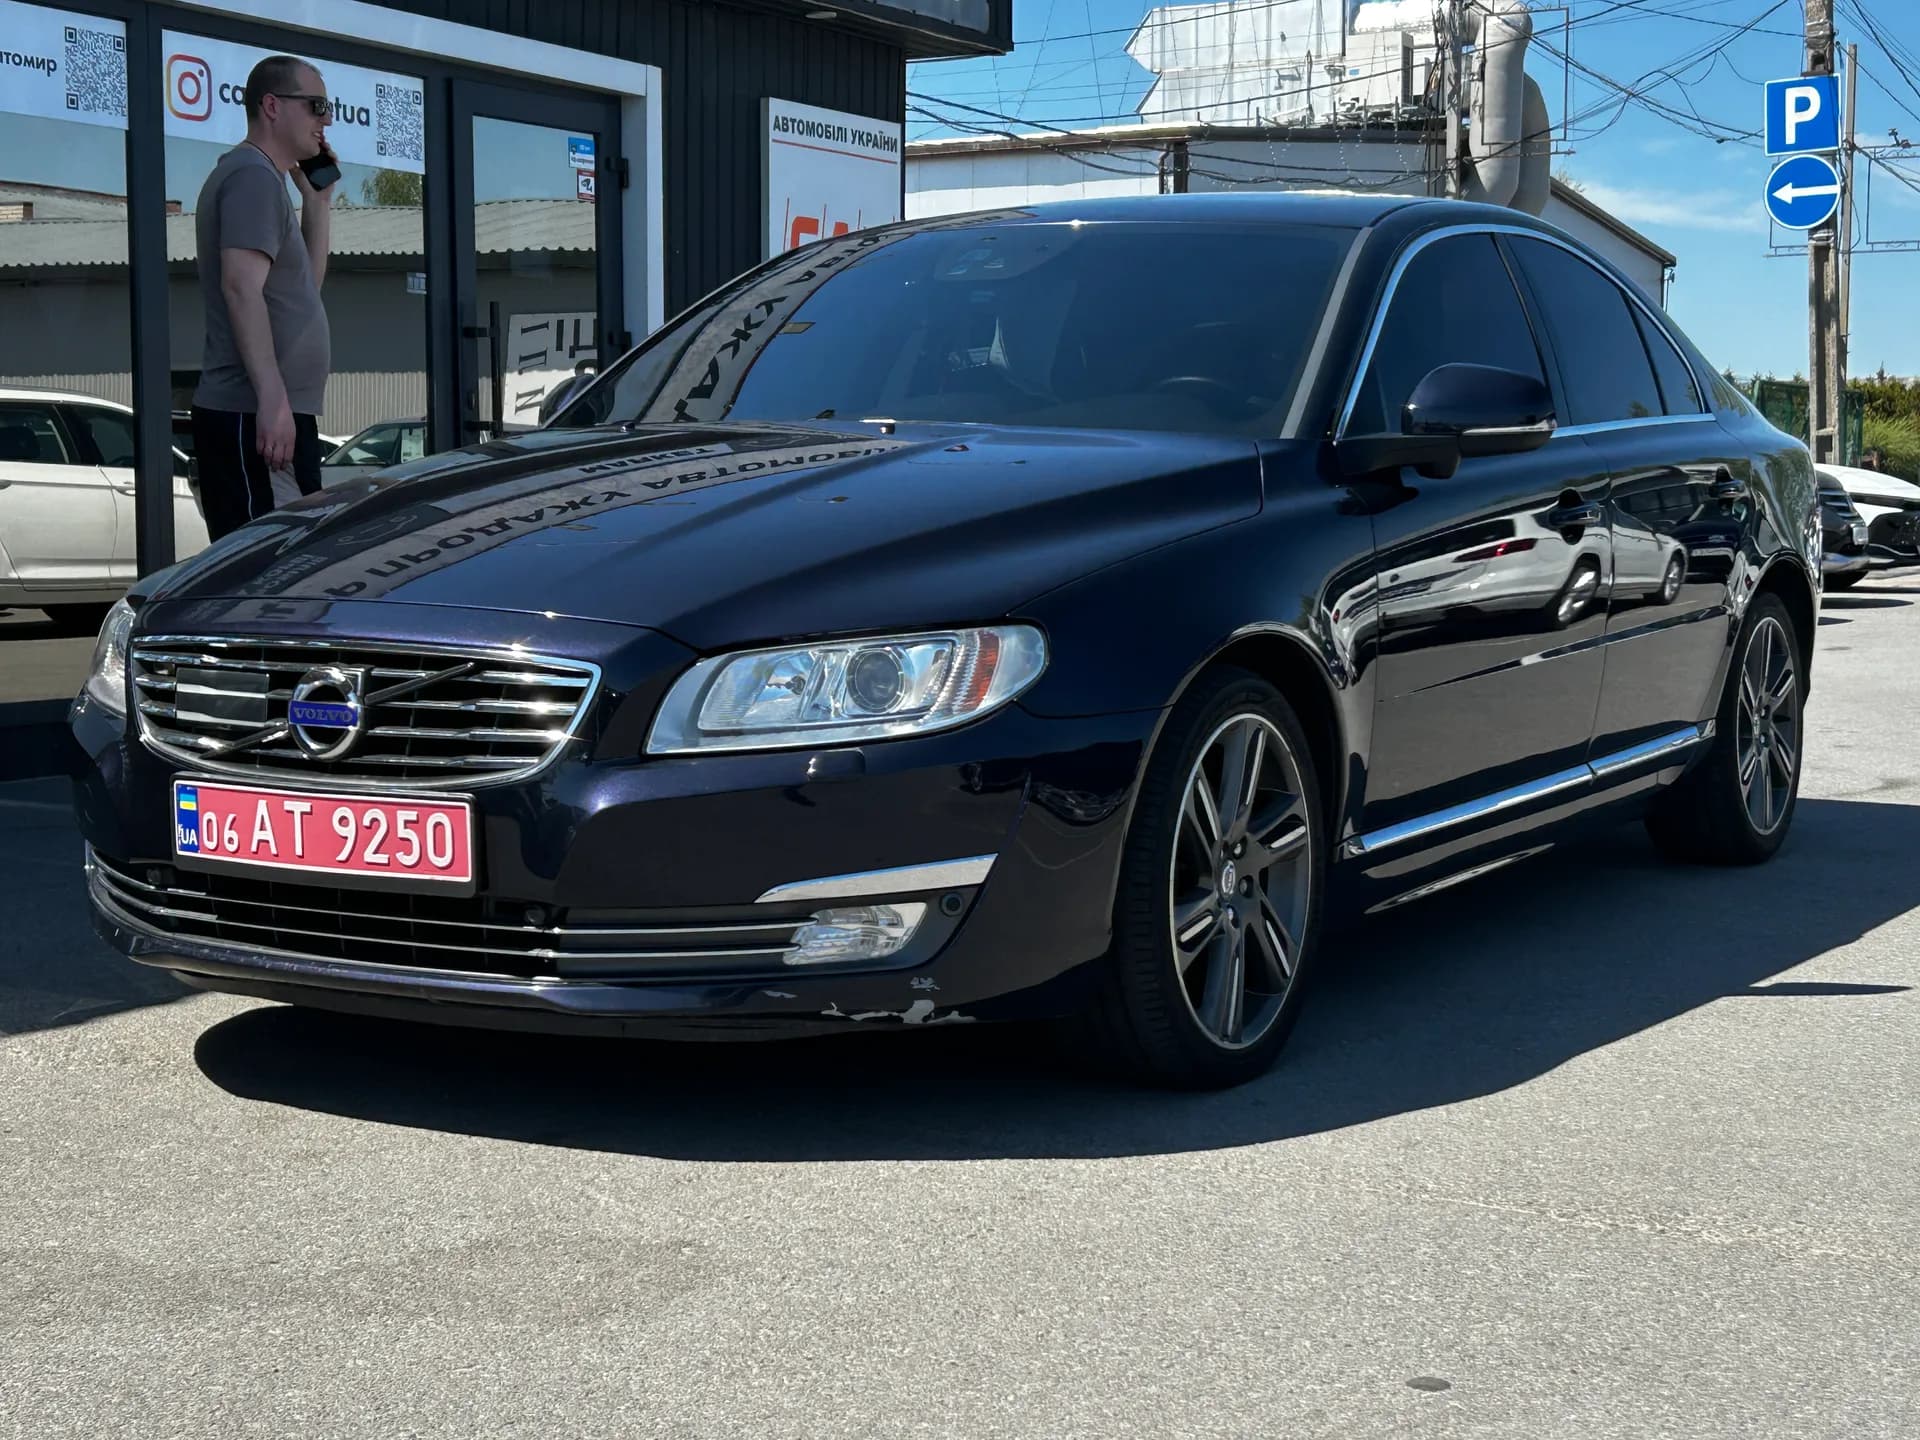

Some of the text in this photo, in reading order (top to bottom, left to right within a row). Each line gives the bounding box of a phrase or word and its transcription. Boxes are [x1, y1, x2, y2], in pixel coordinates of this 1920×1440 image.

[0, 51, 57, 77] томир
[1785, 86, 1821, 144] P
[773, 115, 898, 153] АВТОМОБІЛІ УКРАЇНИ
[292, 706, 354, 723] VOLVO
[181, 828, 198, 846] UA
[202, 799, 454, 868] 06 AT 9250
